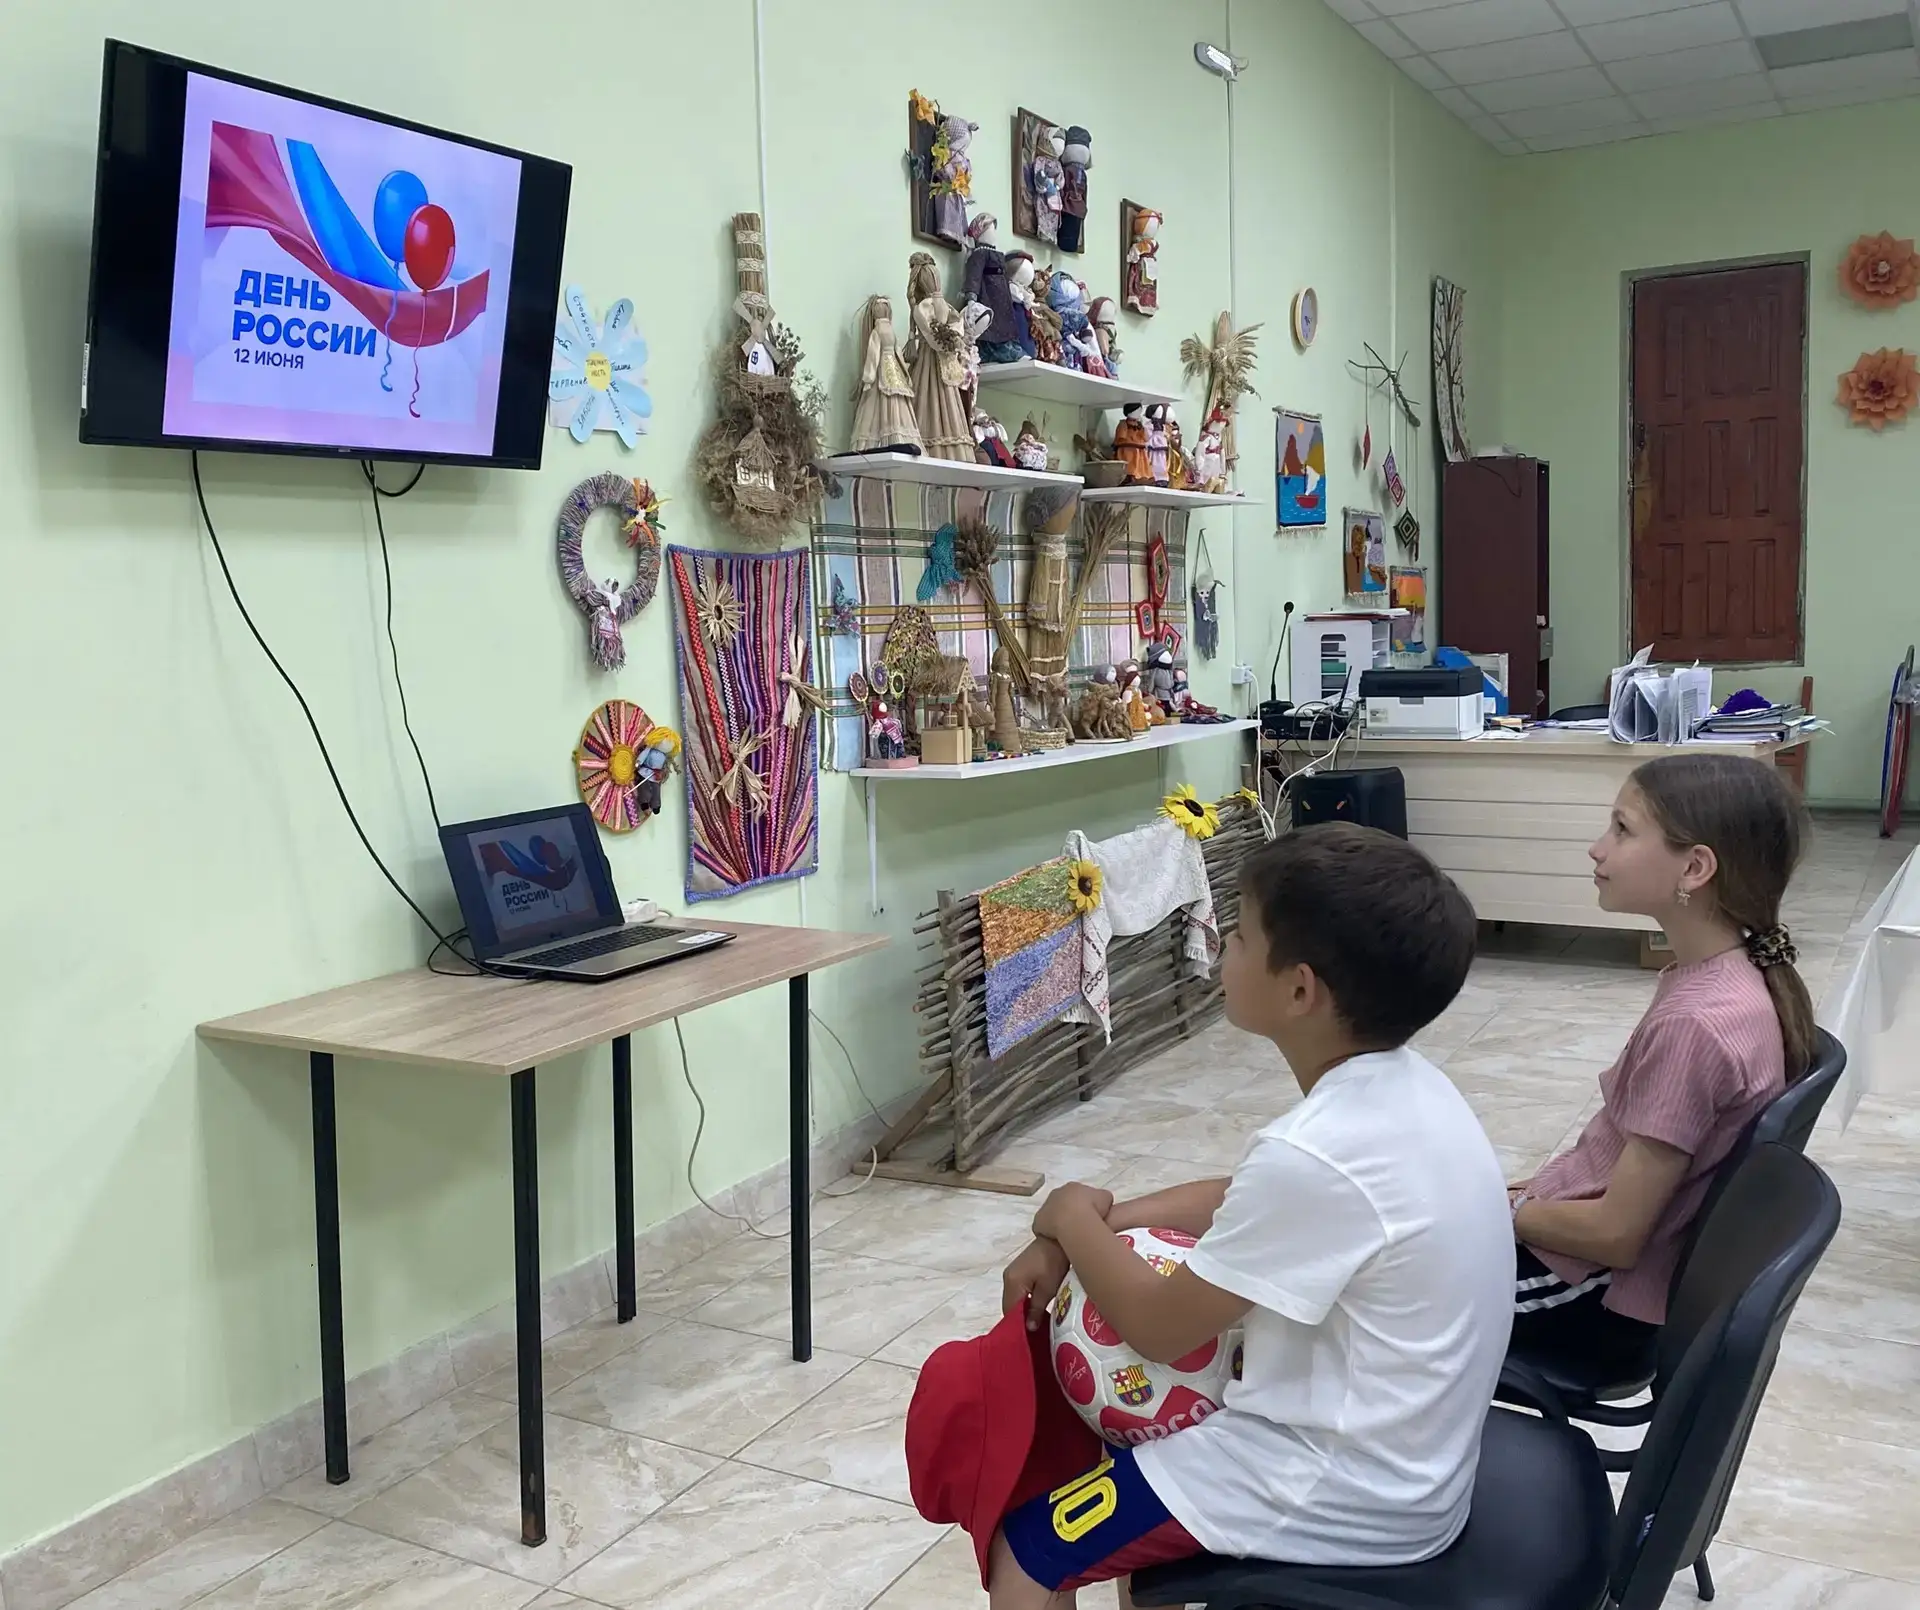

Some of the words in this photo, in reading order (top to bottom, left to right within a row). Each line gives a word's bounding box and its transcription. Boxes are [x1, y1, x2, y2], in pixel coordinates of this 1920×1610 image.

[234, 269, 331, 311] ДЕНЬ
[232, 310, 377, 357] РОССИИ
[233, 348, 250, 363] 12
[254, 350, 304, 370] ИЮНЯ
[502, 880, 531, 897] ДЕНЬ
[505, 889, 549, 908] РОССИИ
[1049, 1458, 1117, 1542] 10
